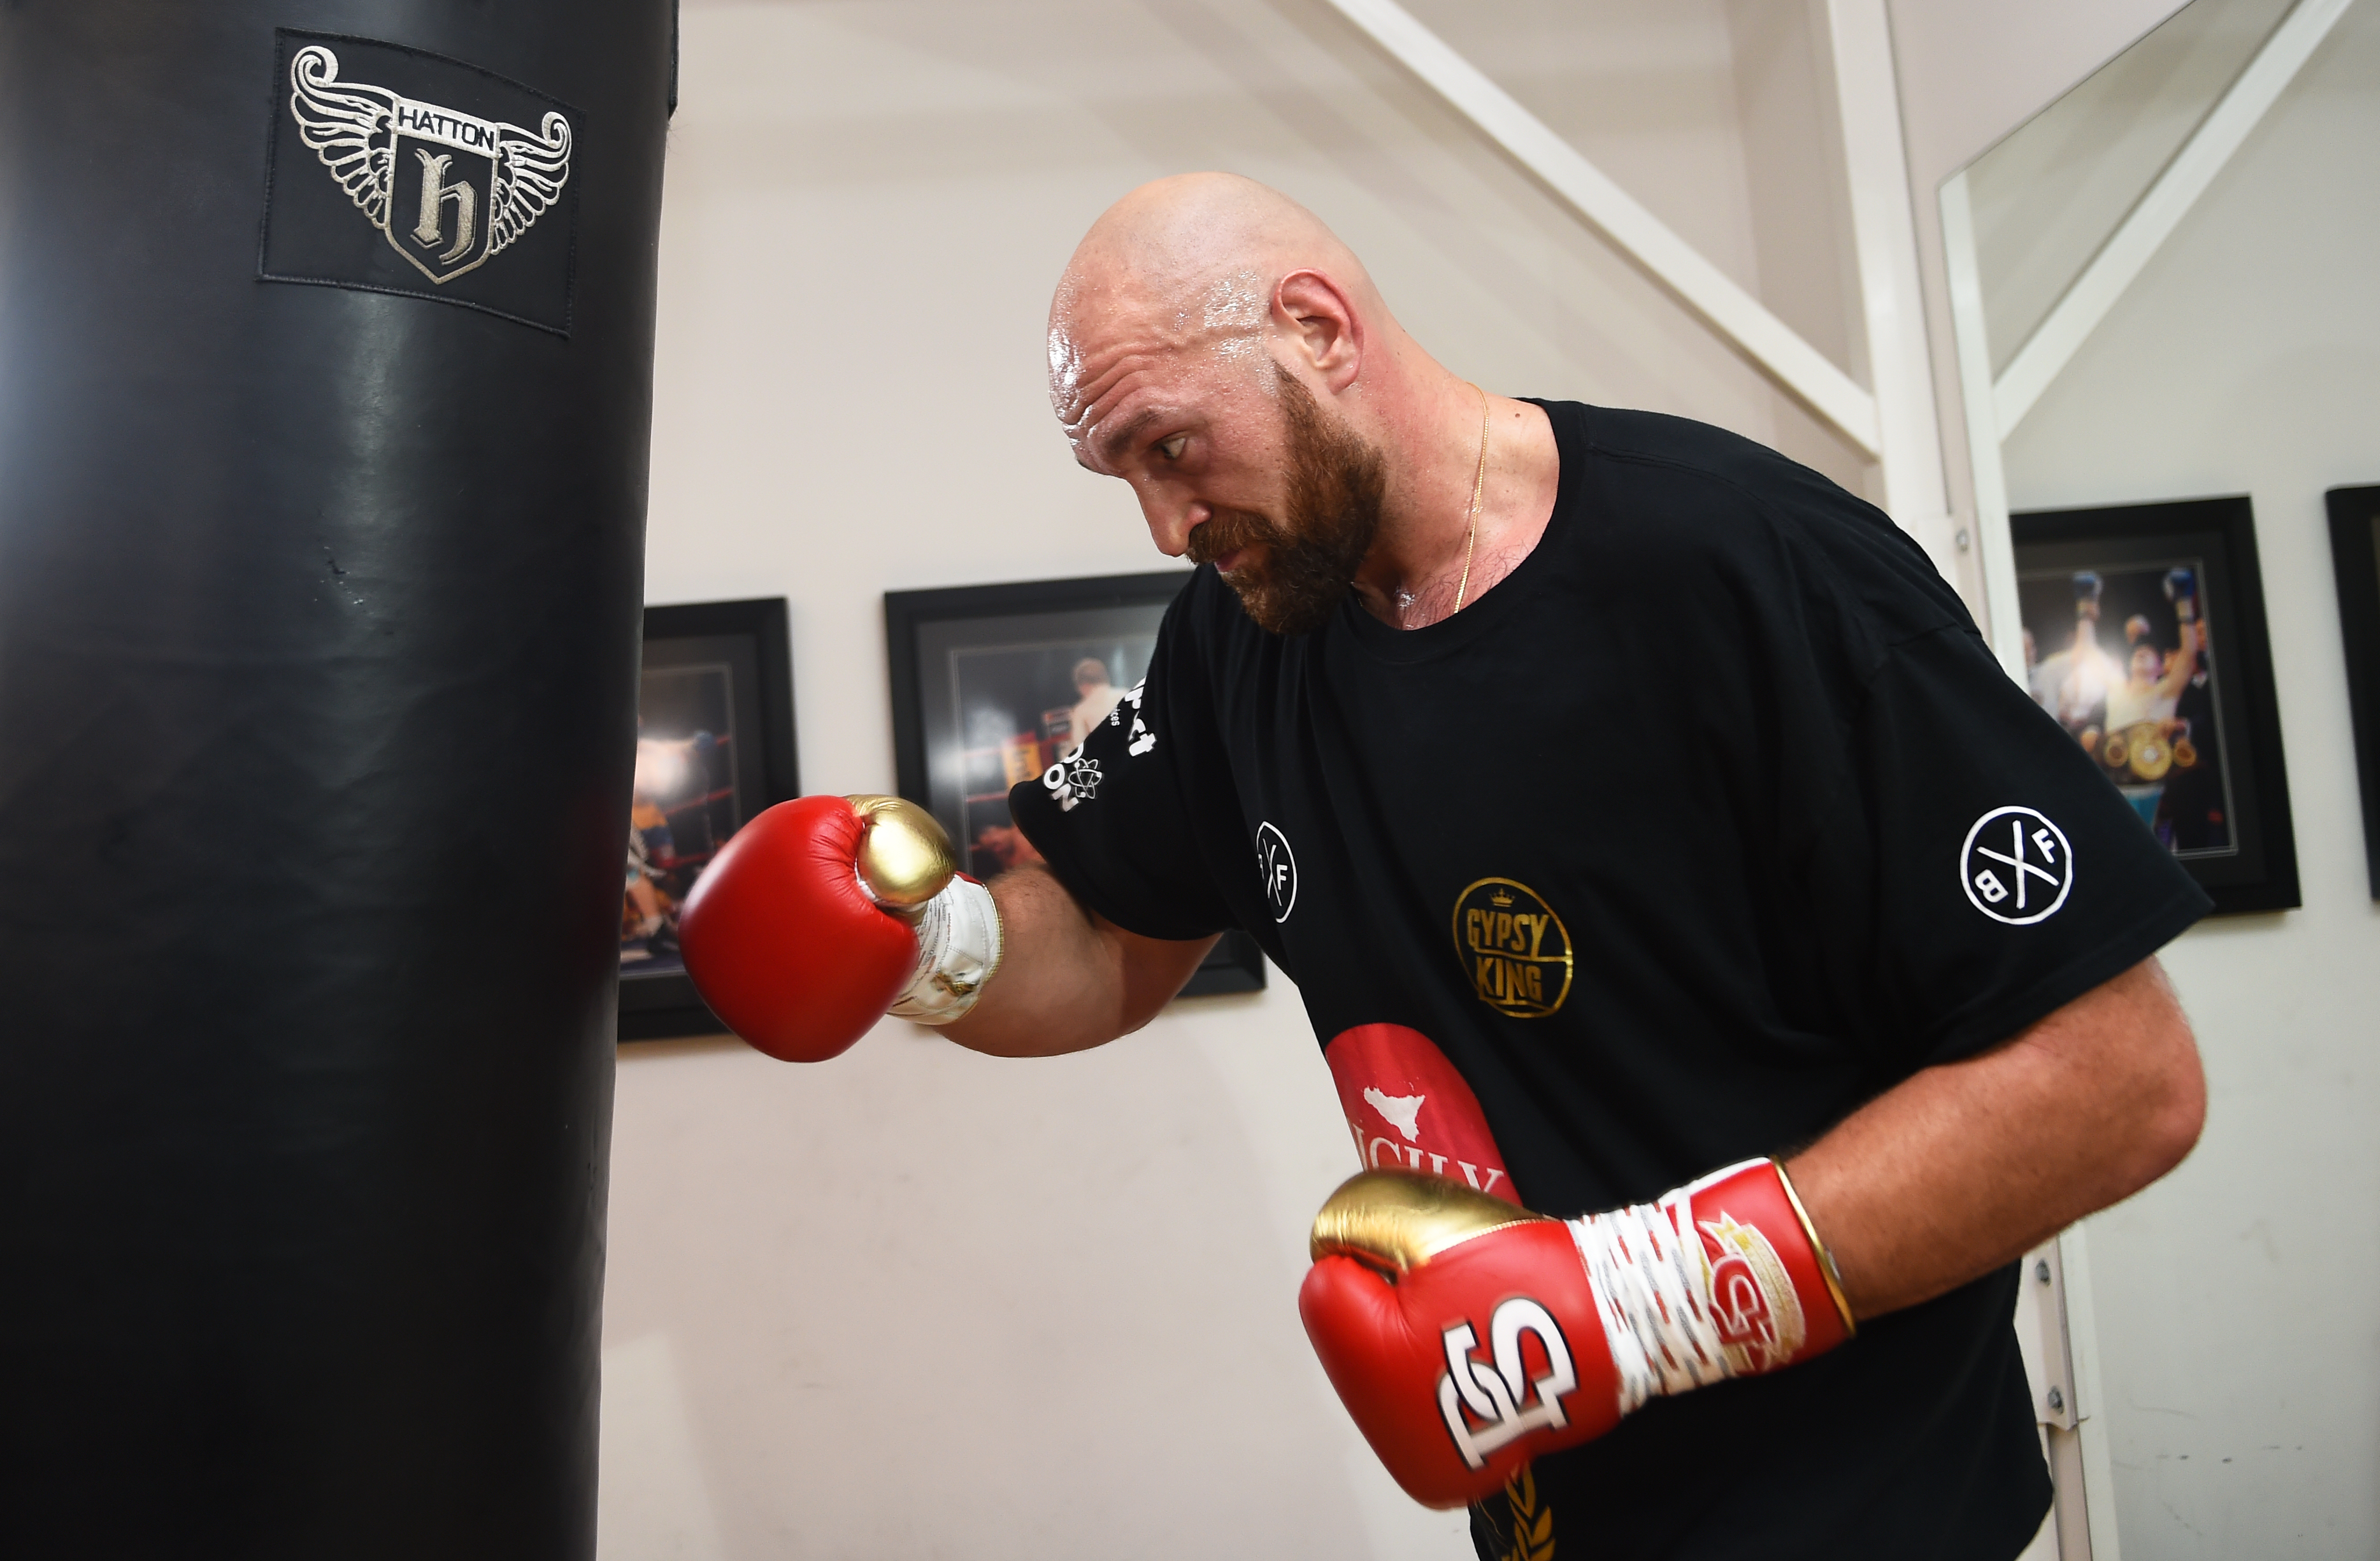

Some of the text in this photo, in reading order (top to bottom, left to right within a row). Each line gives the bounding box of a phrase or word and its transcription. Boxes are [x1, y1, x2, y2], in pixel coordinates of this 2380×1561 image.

[398, 106, 495, 151] HATTON
[1466, 908, 1550, 959] GYPSY
[1476, 956, 1543, 1005] KING
